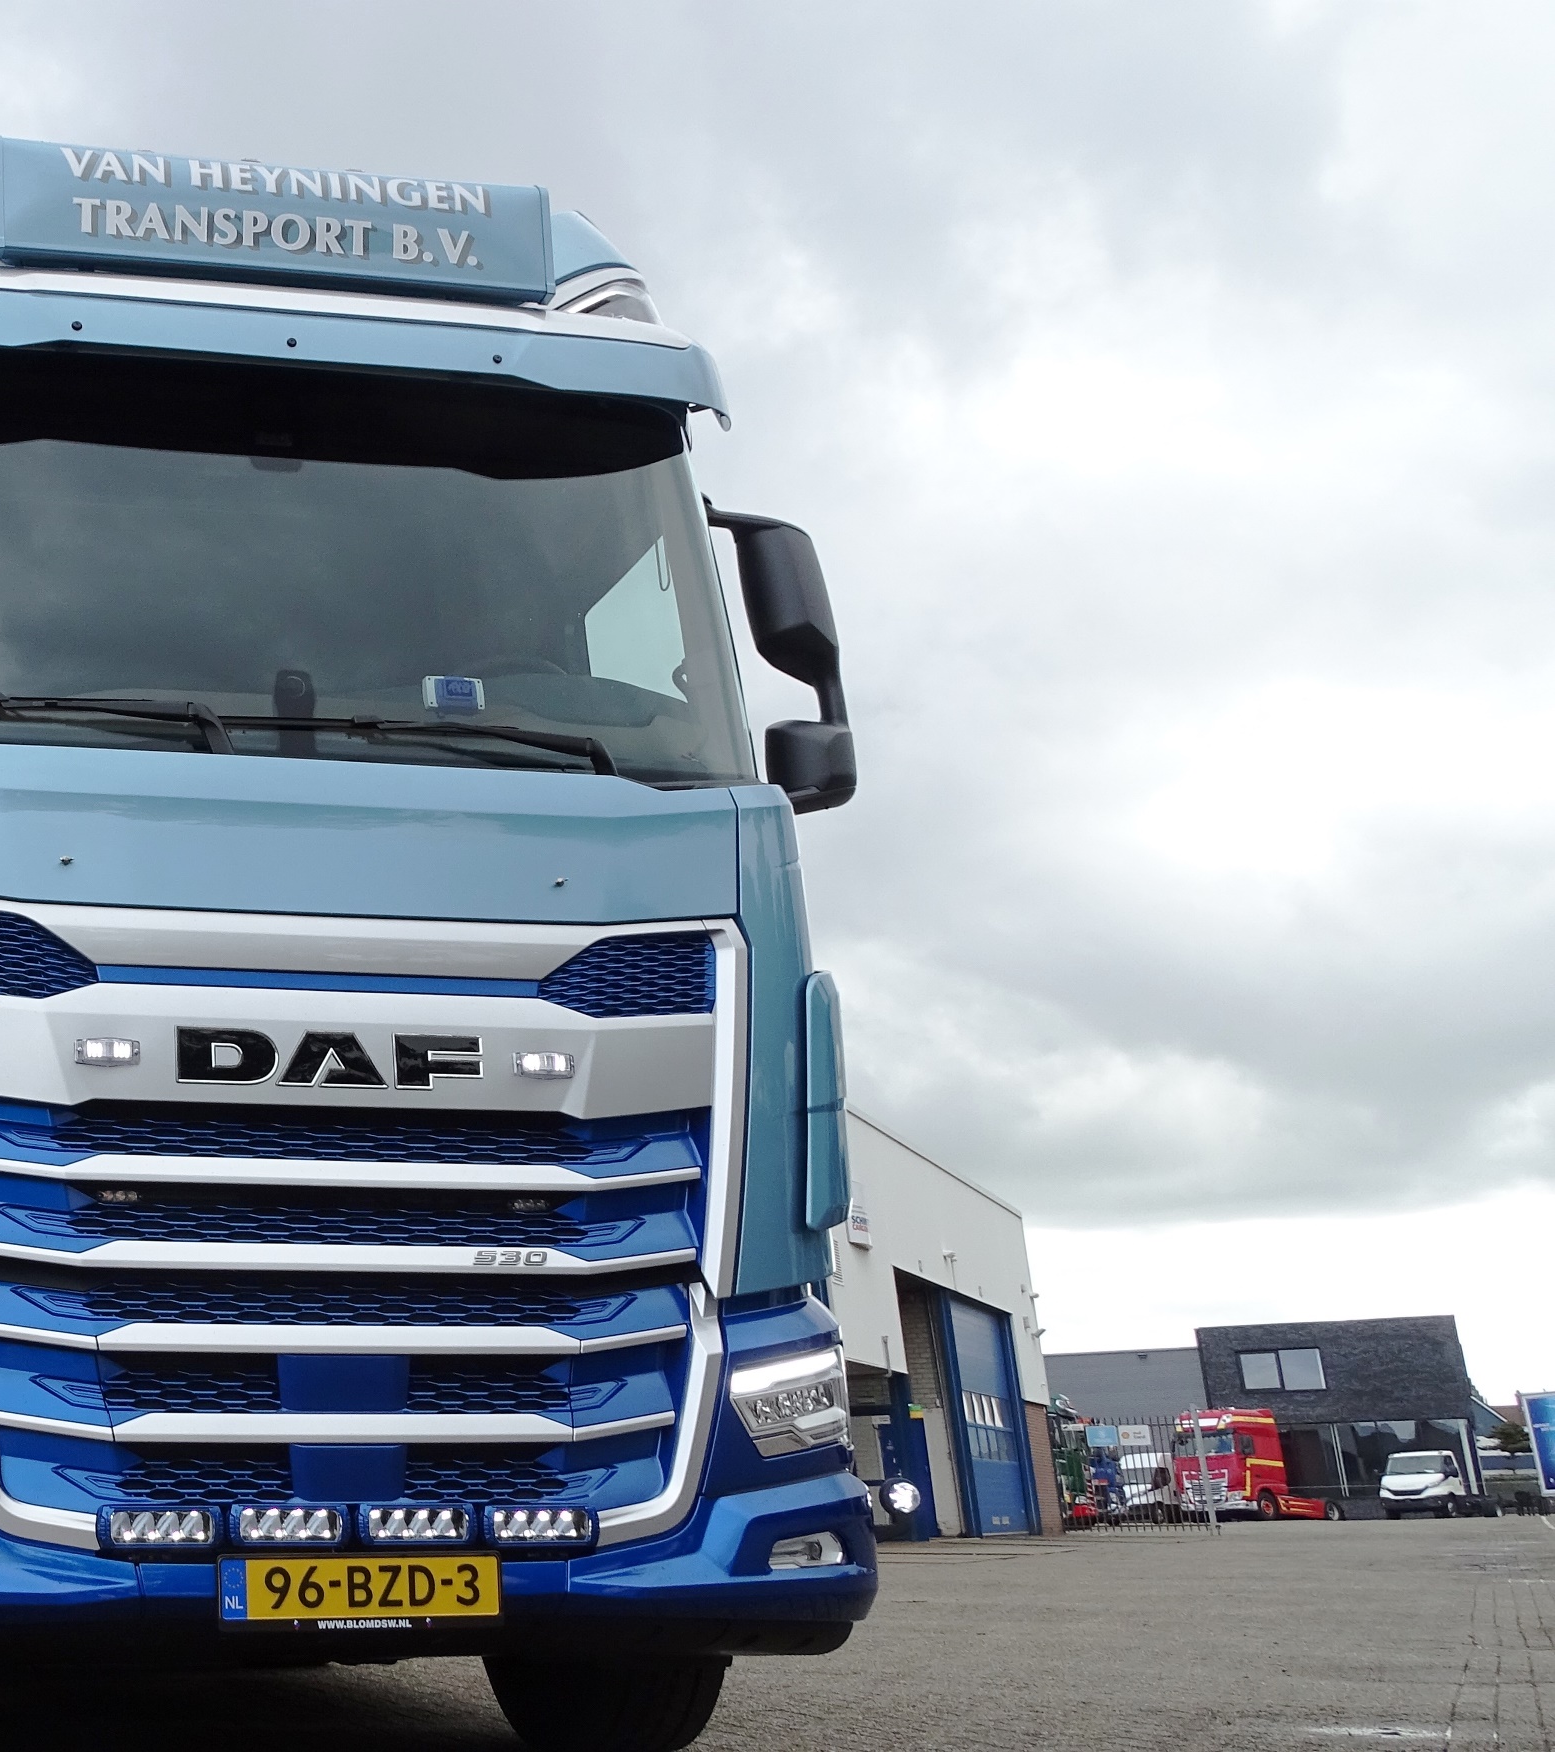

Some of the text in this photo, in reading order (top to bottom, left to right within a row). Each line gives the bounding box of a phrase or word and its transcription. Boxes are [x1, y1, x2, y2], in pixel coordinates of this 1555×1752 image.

[59, 147, 492, 216] VAN HEYNINGEN
[72, 197, 373, 258] TRANSPORT
[174, 1025, 484, 1091] DAF
[473, 1250, 548, 1266] 530
[225, 1595, 244, 1610] NL
[264, 1563, 480, 1610] 96-BZD-3
[317, 1619, 412, 1631] WWW.BLOMDSW.NL
